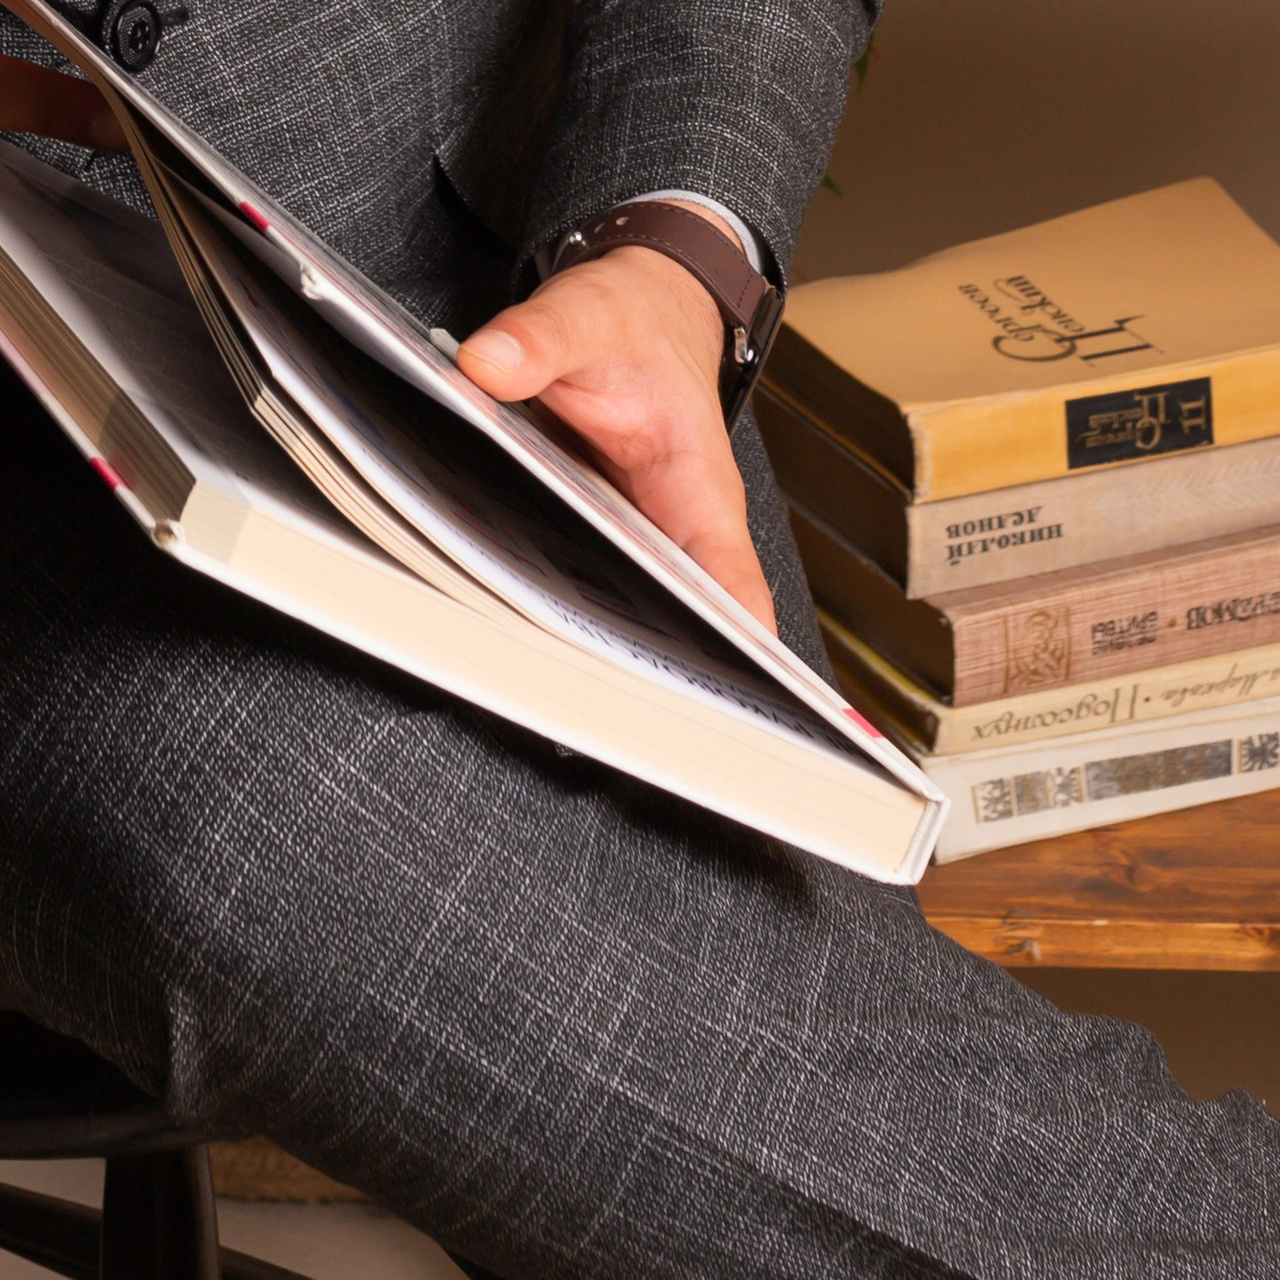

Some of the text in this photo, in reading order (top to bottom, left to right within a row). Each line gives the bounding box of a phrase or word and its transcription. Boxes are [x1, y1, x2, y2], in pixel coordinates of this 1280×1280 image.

[946, 504, 1044, 539] АСАНОВ
[946, 522, 1064, 568] НИКОЛАЙ
[972, 683, 1141, 741] Подсолнух
